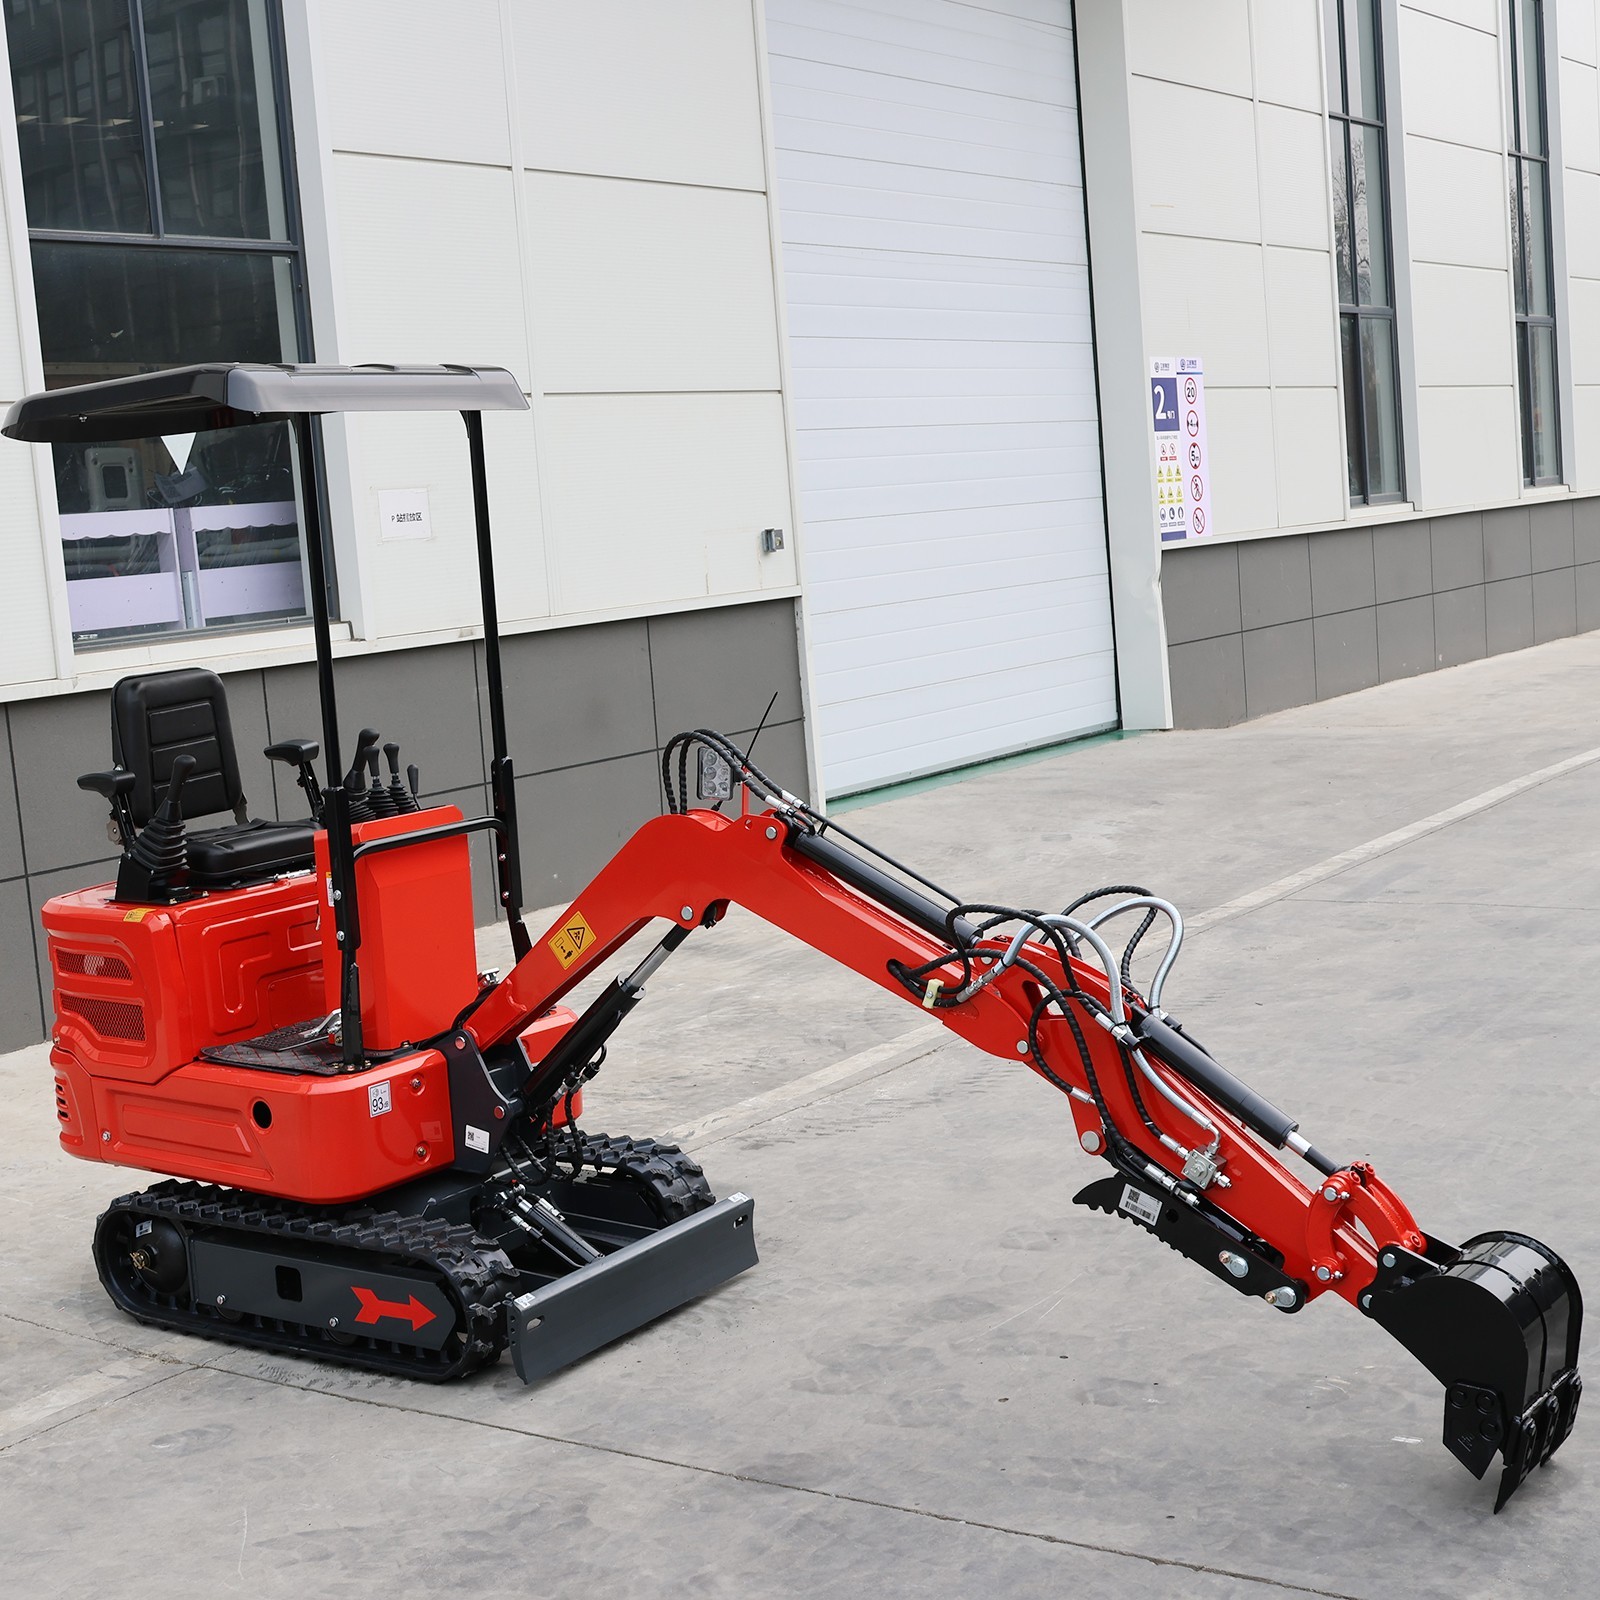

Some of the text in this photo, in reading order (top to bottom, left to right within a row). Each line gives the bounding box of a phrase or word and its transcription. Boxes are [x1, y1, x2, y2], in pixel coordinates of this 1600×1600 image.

[1187, 387, 1195, 398] 20
[1153, 385, 1167, 419] 2
[372, 1096, 384, 1113] 93
